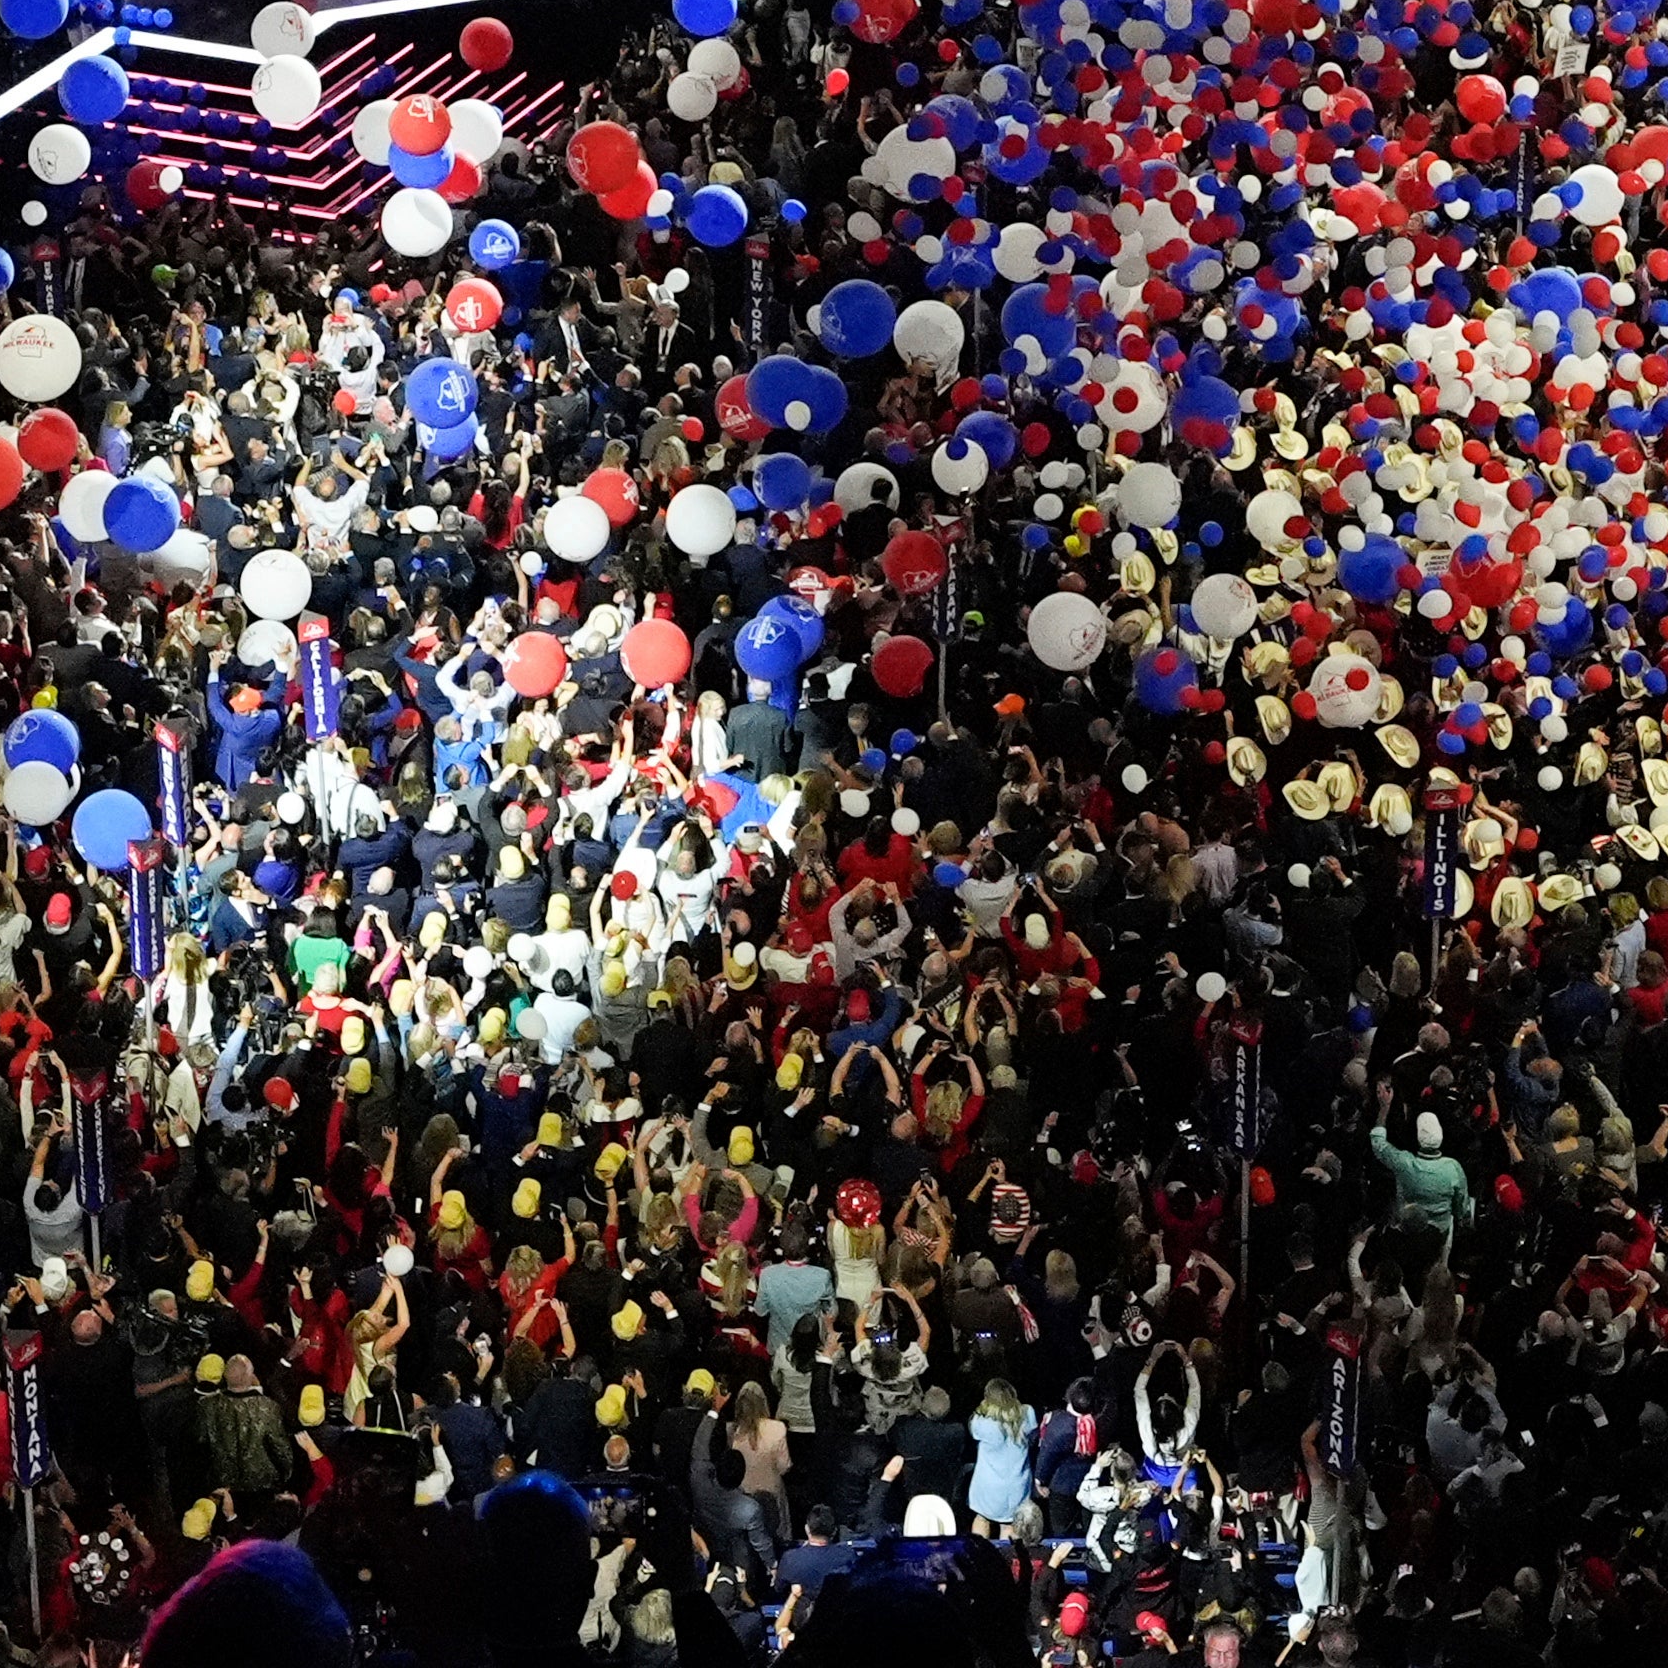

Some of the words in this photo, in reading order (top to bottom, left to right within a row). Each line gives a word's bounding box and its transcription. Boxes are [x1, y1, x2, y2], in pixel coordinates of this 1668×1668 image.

[751, 260, 763, 292] NEW
[751, 297, 763, 343] YORK
[946, 543, 956, 636] ALABAMA
[311, 640, 327, 734] CALIFORNIA
[161, 747, 180, 841] NEVADA
[1433, 814, 1448, 911] ILLINOIS
[1235, 1045, 1246, 1149] ARKANSAS
[23, 1364, 43, 1479] MONTANA
[1327, 1358, 1346, 1470] ARIZONA
